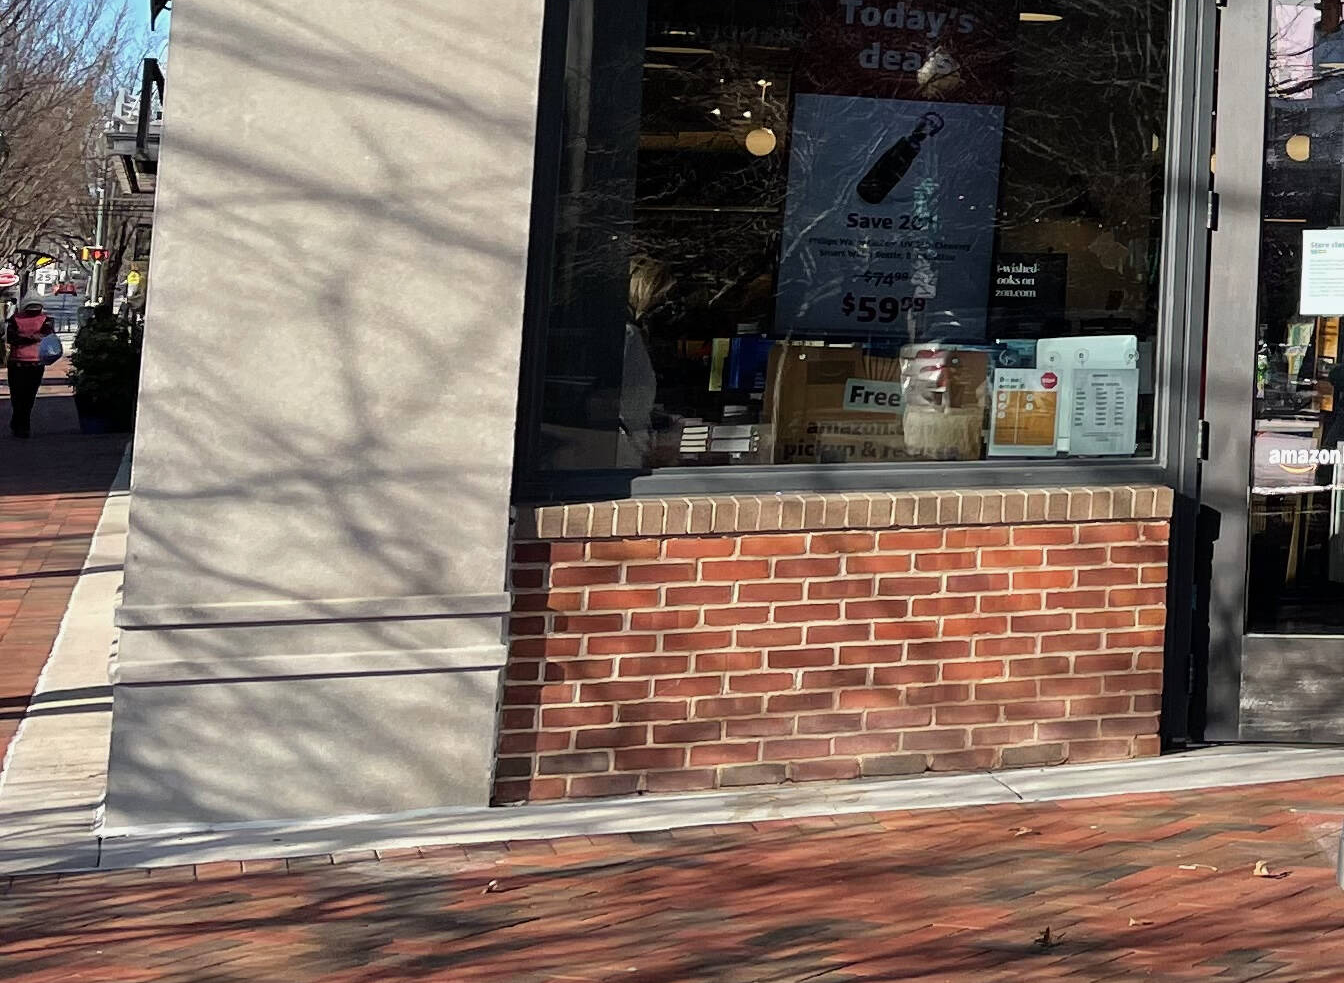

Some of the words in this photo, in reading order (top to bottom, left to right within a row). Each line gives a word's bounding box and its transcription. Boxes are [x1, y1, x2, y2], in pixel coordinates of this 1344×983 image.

[859, 42, 953, 74] deas
[846, 213, 893, 231] Save
[996, 275, 1020, 285] ooks
[849, 385, 901, 406] Free
[862, 441, 876, 459] &
